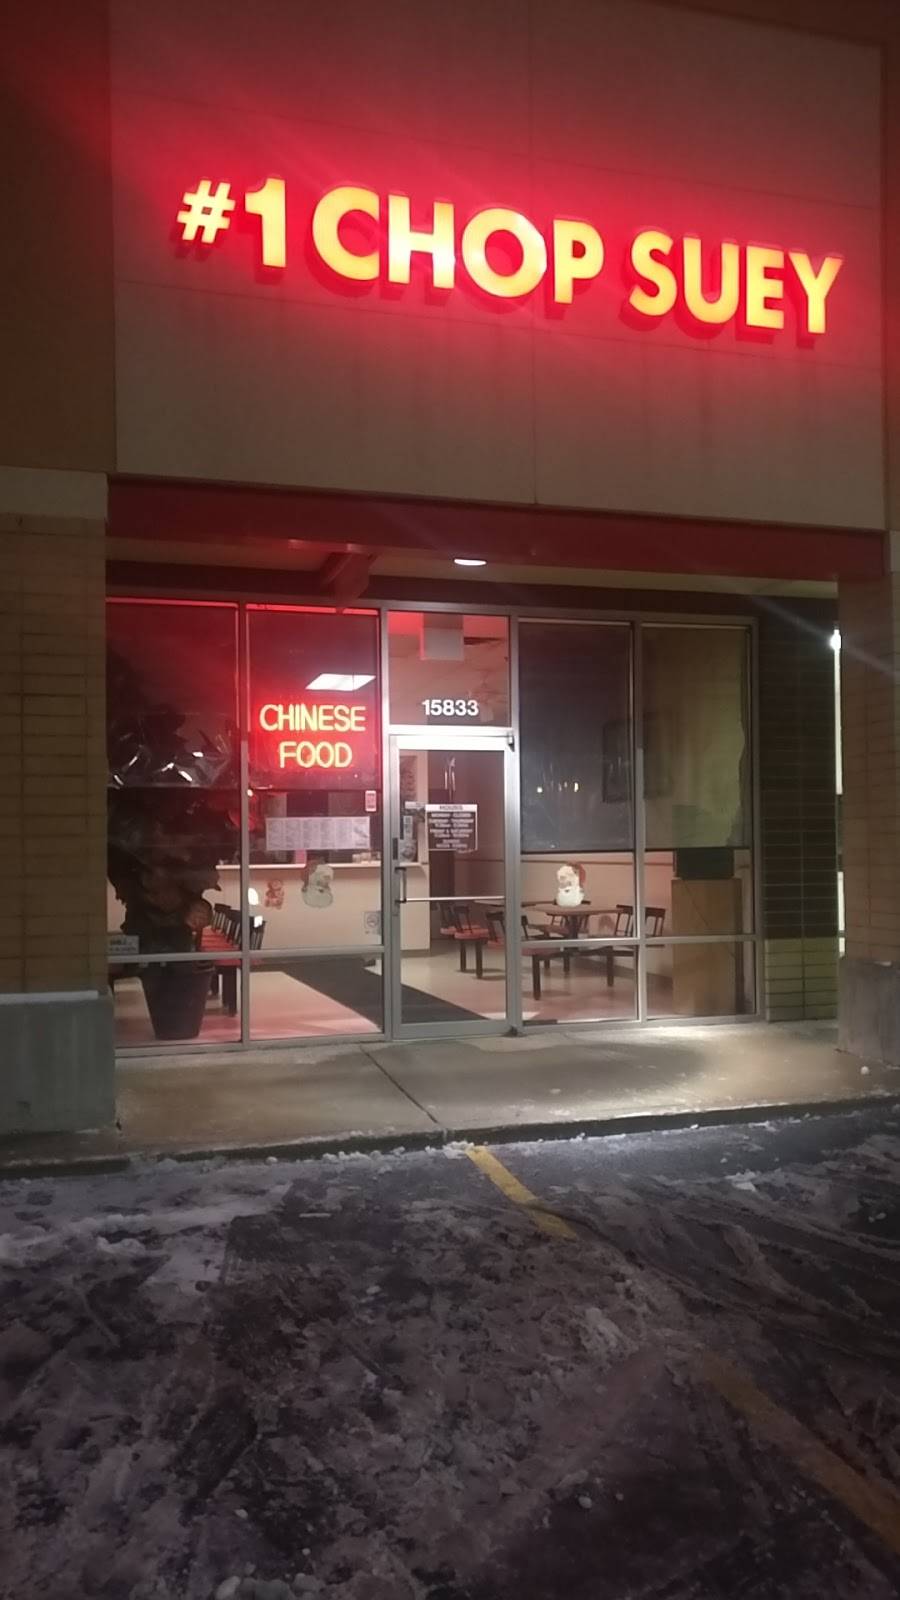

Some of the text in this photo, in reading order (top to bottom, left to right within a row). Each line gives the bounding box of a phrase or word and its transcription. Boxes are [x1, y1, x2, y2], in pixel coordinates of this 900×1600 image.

[176, 178, 844, 334] #1 CHOP SUEY
[258, 703, 367, 733] CHINESE
[421, 699, 480, 717] 15833
[278, 740, 353, 769] FOOD
